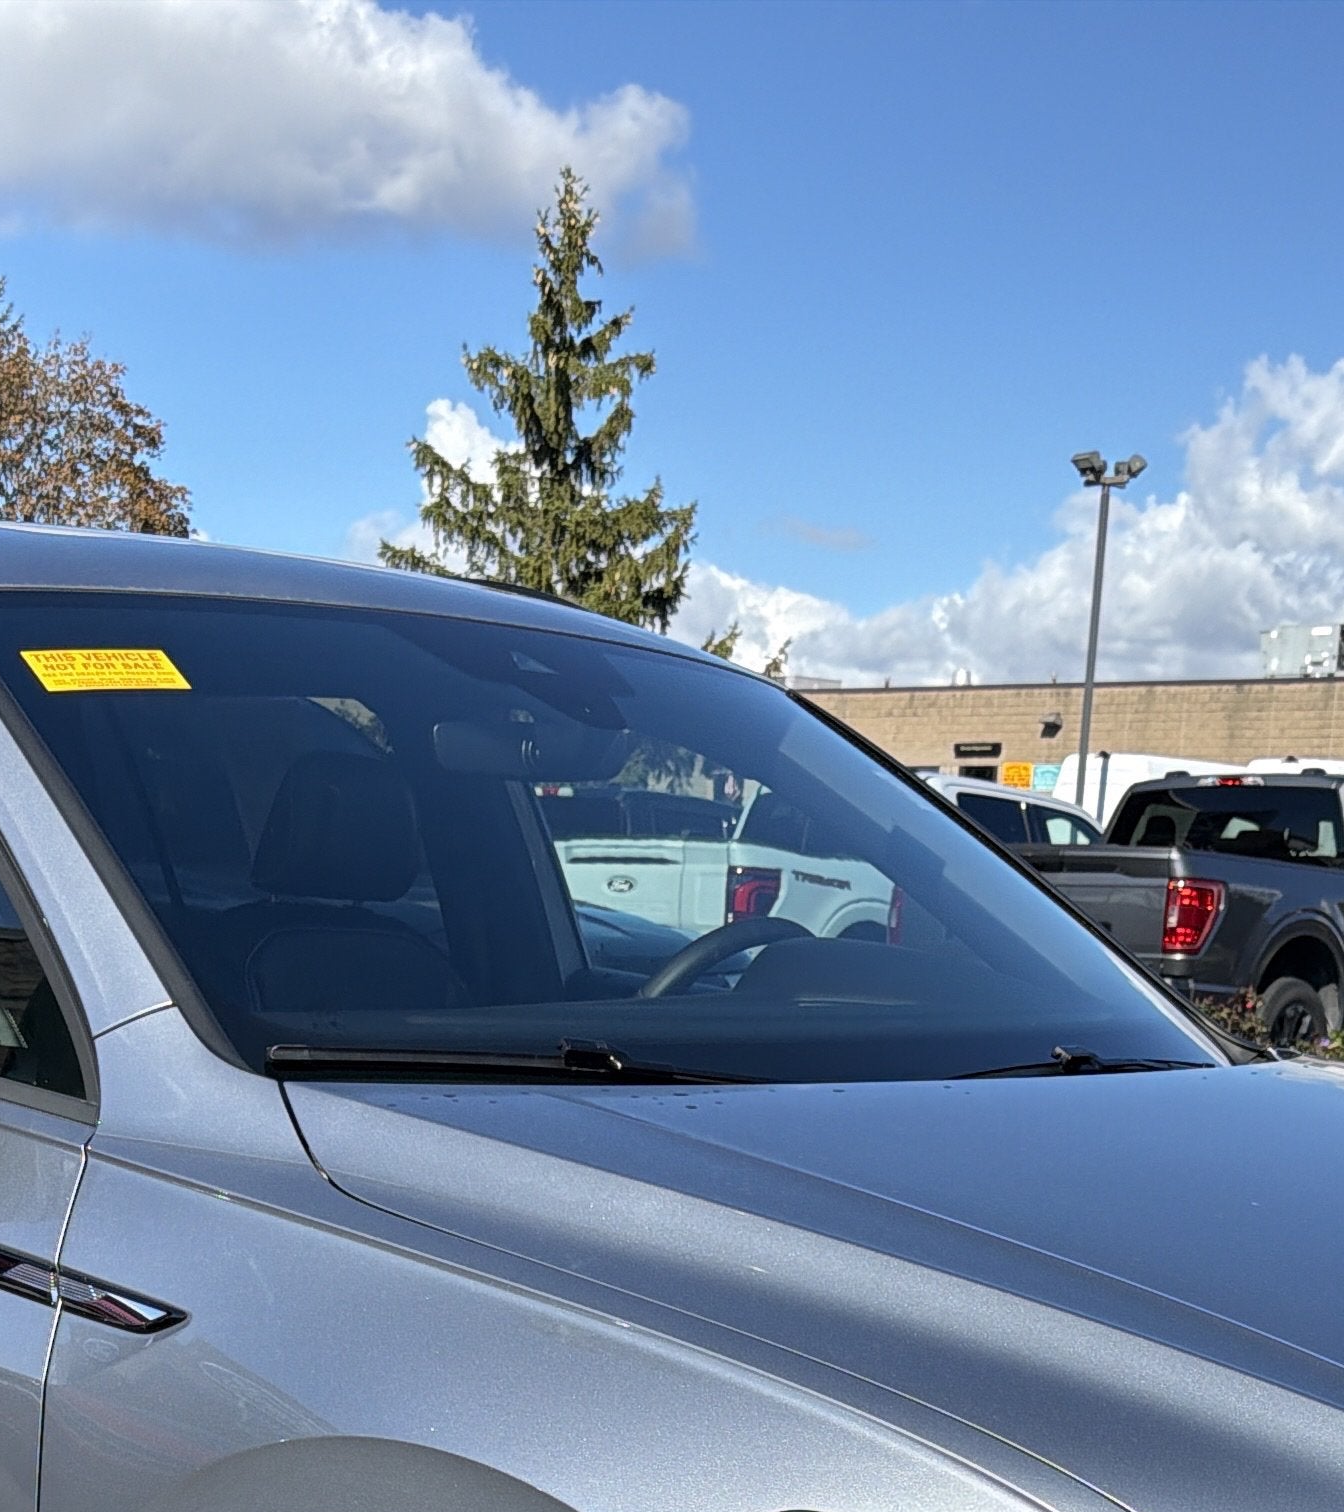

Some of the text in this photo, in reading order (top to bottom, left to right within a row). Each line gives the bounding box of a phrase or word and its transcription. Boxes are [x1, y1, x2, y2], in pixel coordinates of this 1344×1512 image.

[32, 653, 162, 663] THIS VEHICLE
[43, 663, 76, 671] NOT
[82, 663, 116, 671] FOR
